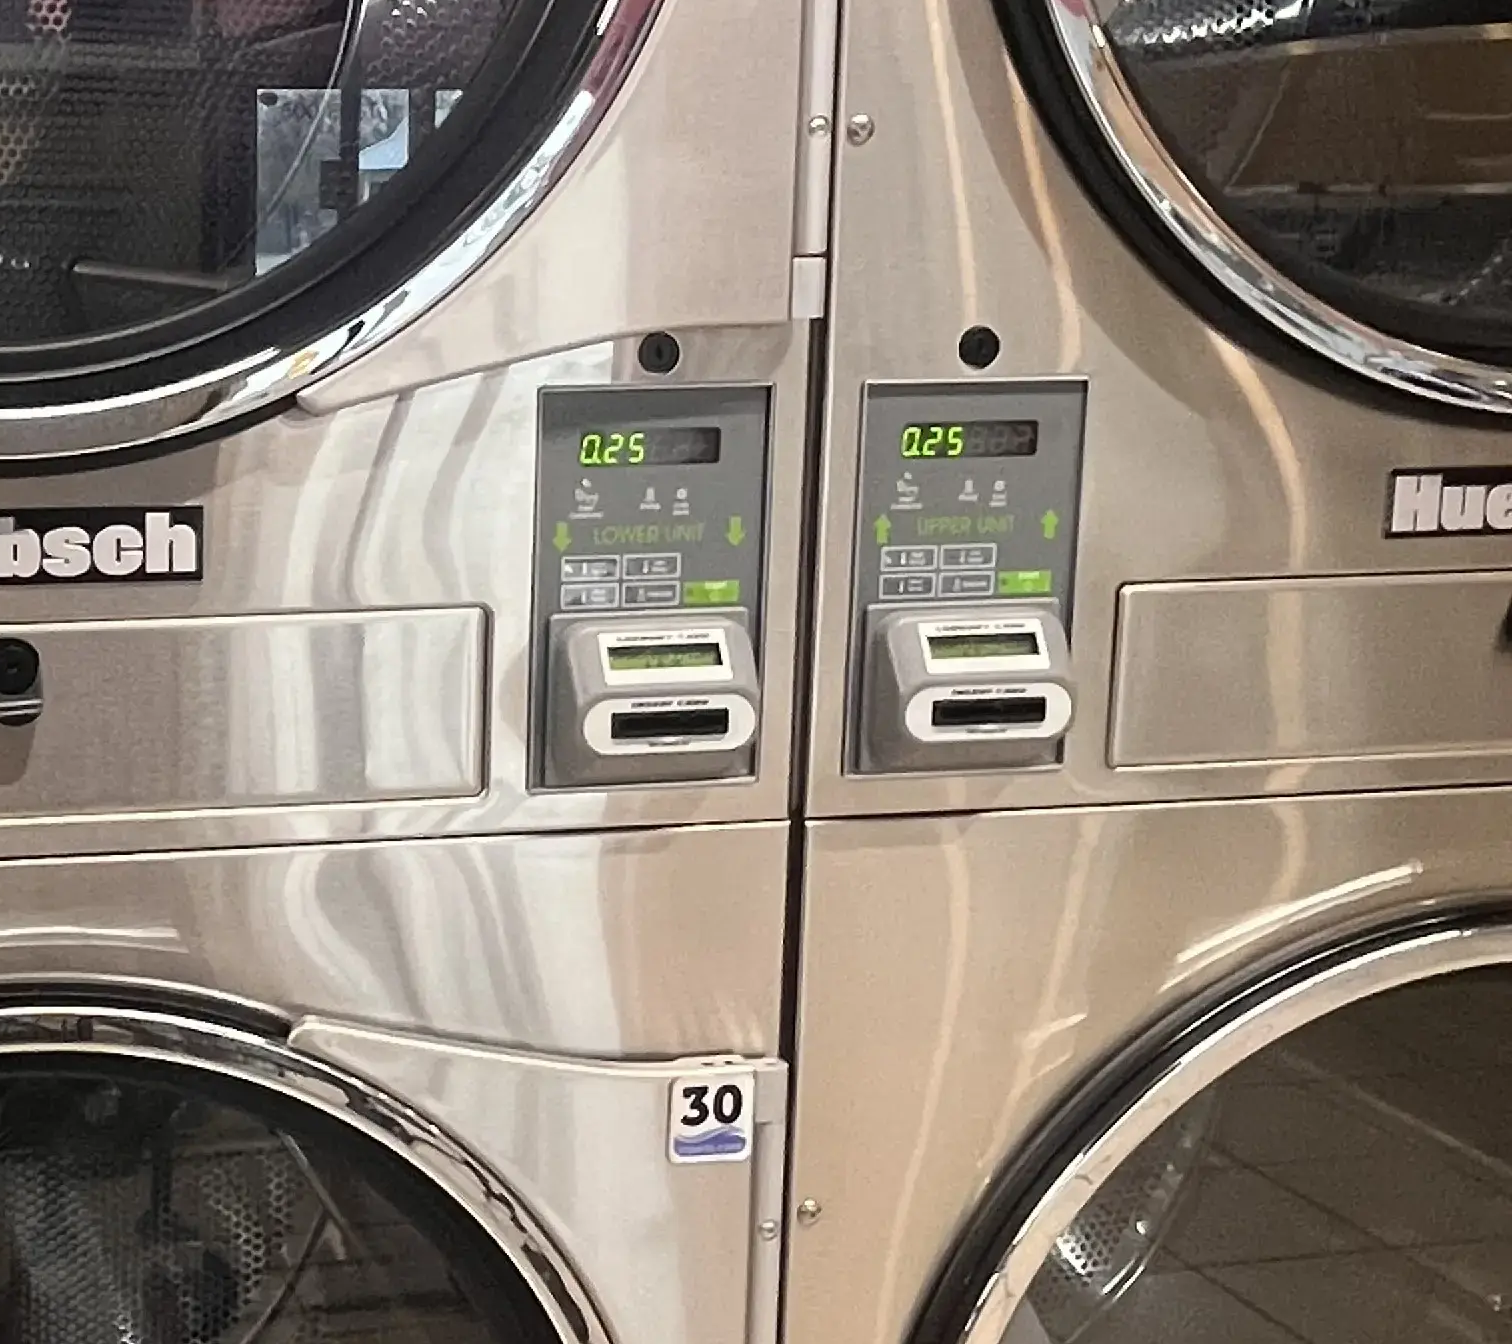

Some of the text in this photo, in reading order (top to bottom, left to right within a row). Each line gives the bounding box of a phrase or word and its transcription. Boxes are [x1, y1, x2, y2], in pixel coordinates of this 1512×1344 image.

[579, 432, 646, 464] 0.25
[902, 426, 964, 457] 0.25
[593, 520, 706, 546] LOWER UNIT
[916, 513, 1015, 537] UPPER UNIT
[680, 1084, 743, 1127] 30
